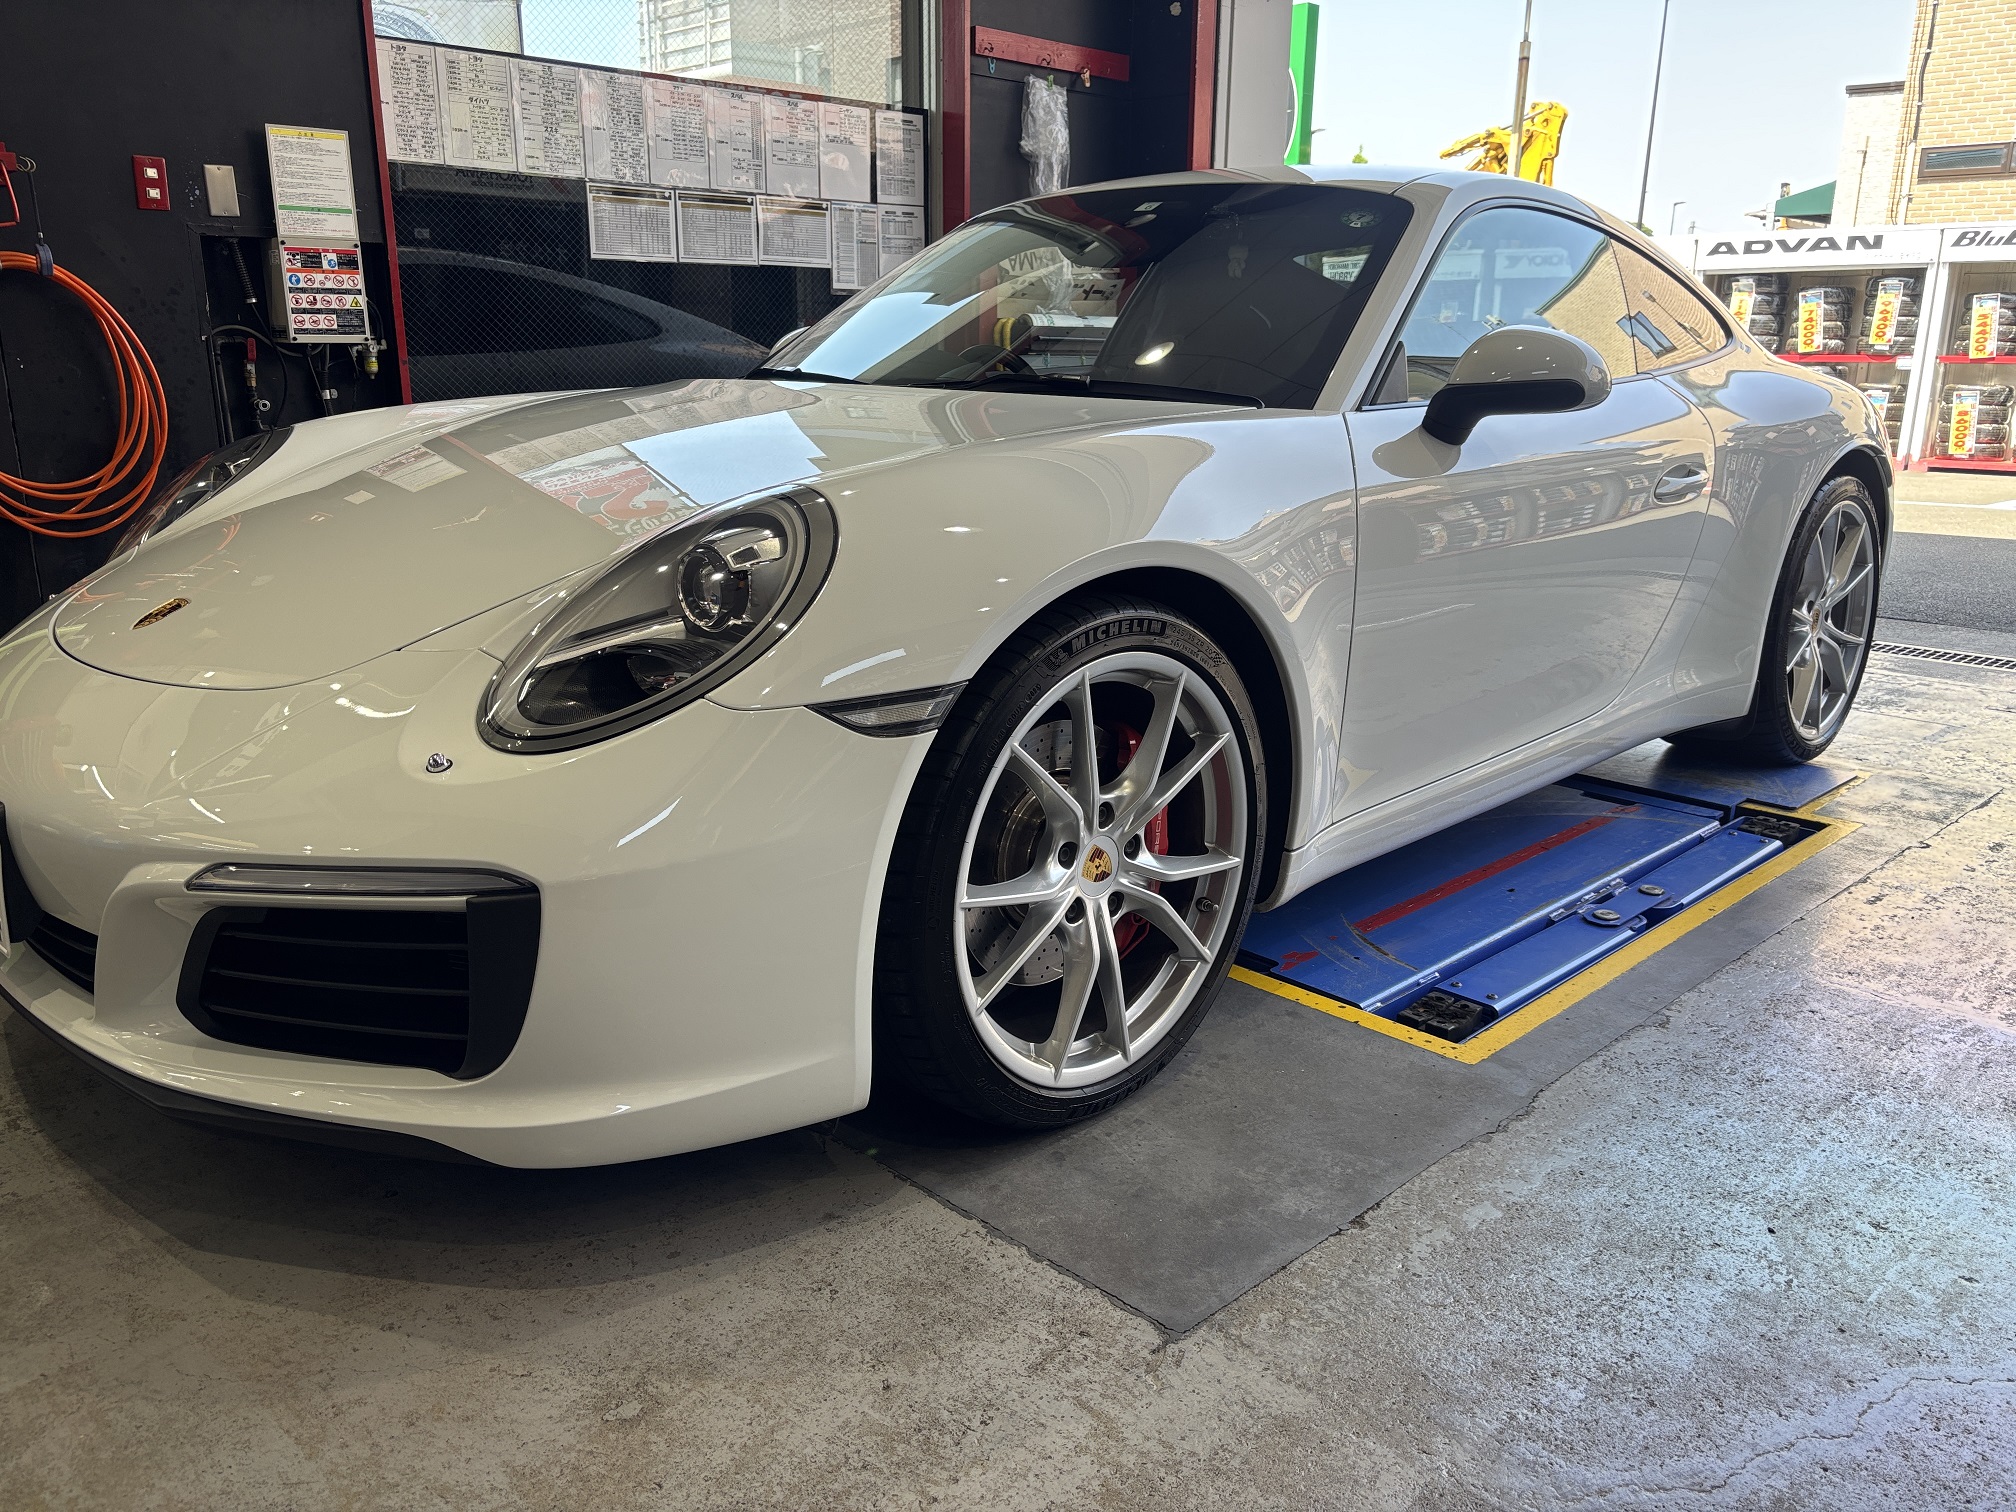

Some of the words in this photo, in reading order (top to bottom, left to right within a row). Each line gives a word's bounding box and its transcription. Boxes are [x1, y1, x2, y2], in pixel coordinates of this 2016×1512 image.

[468, 97, 490, 105] ダイハツ
[1706, 234, 1884, 257] ADVAN
[1974, 313, 1990, 352] 54400
[1071, 619, 1163, 654] MICHELIN
